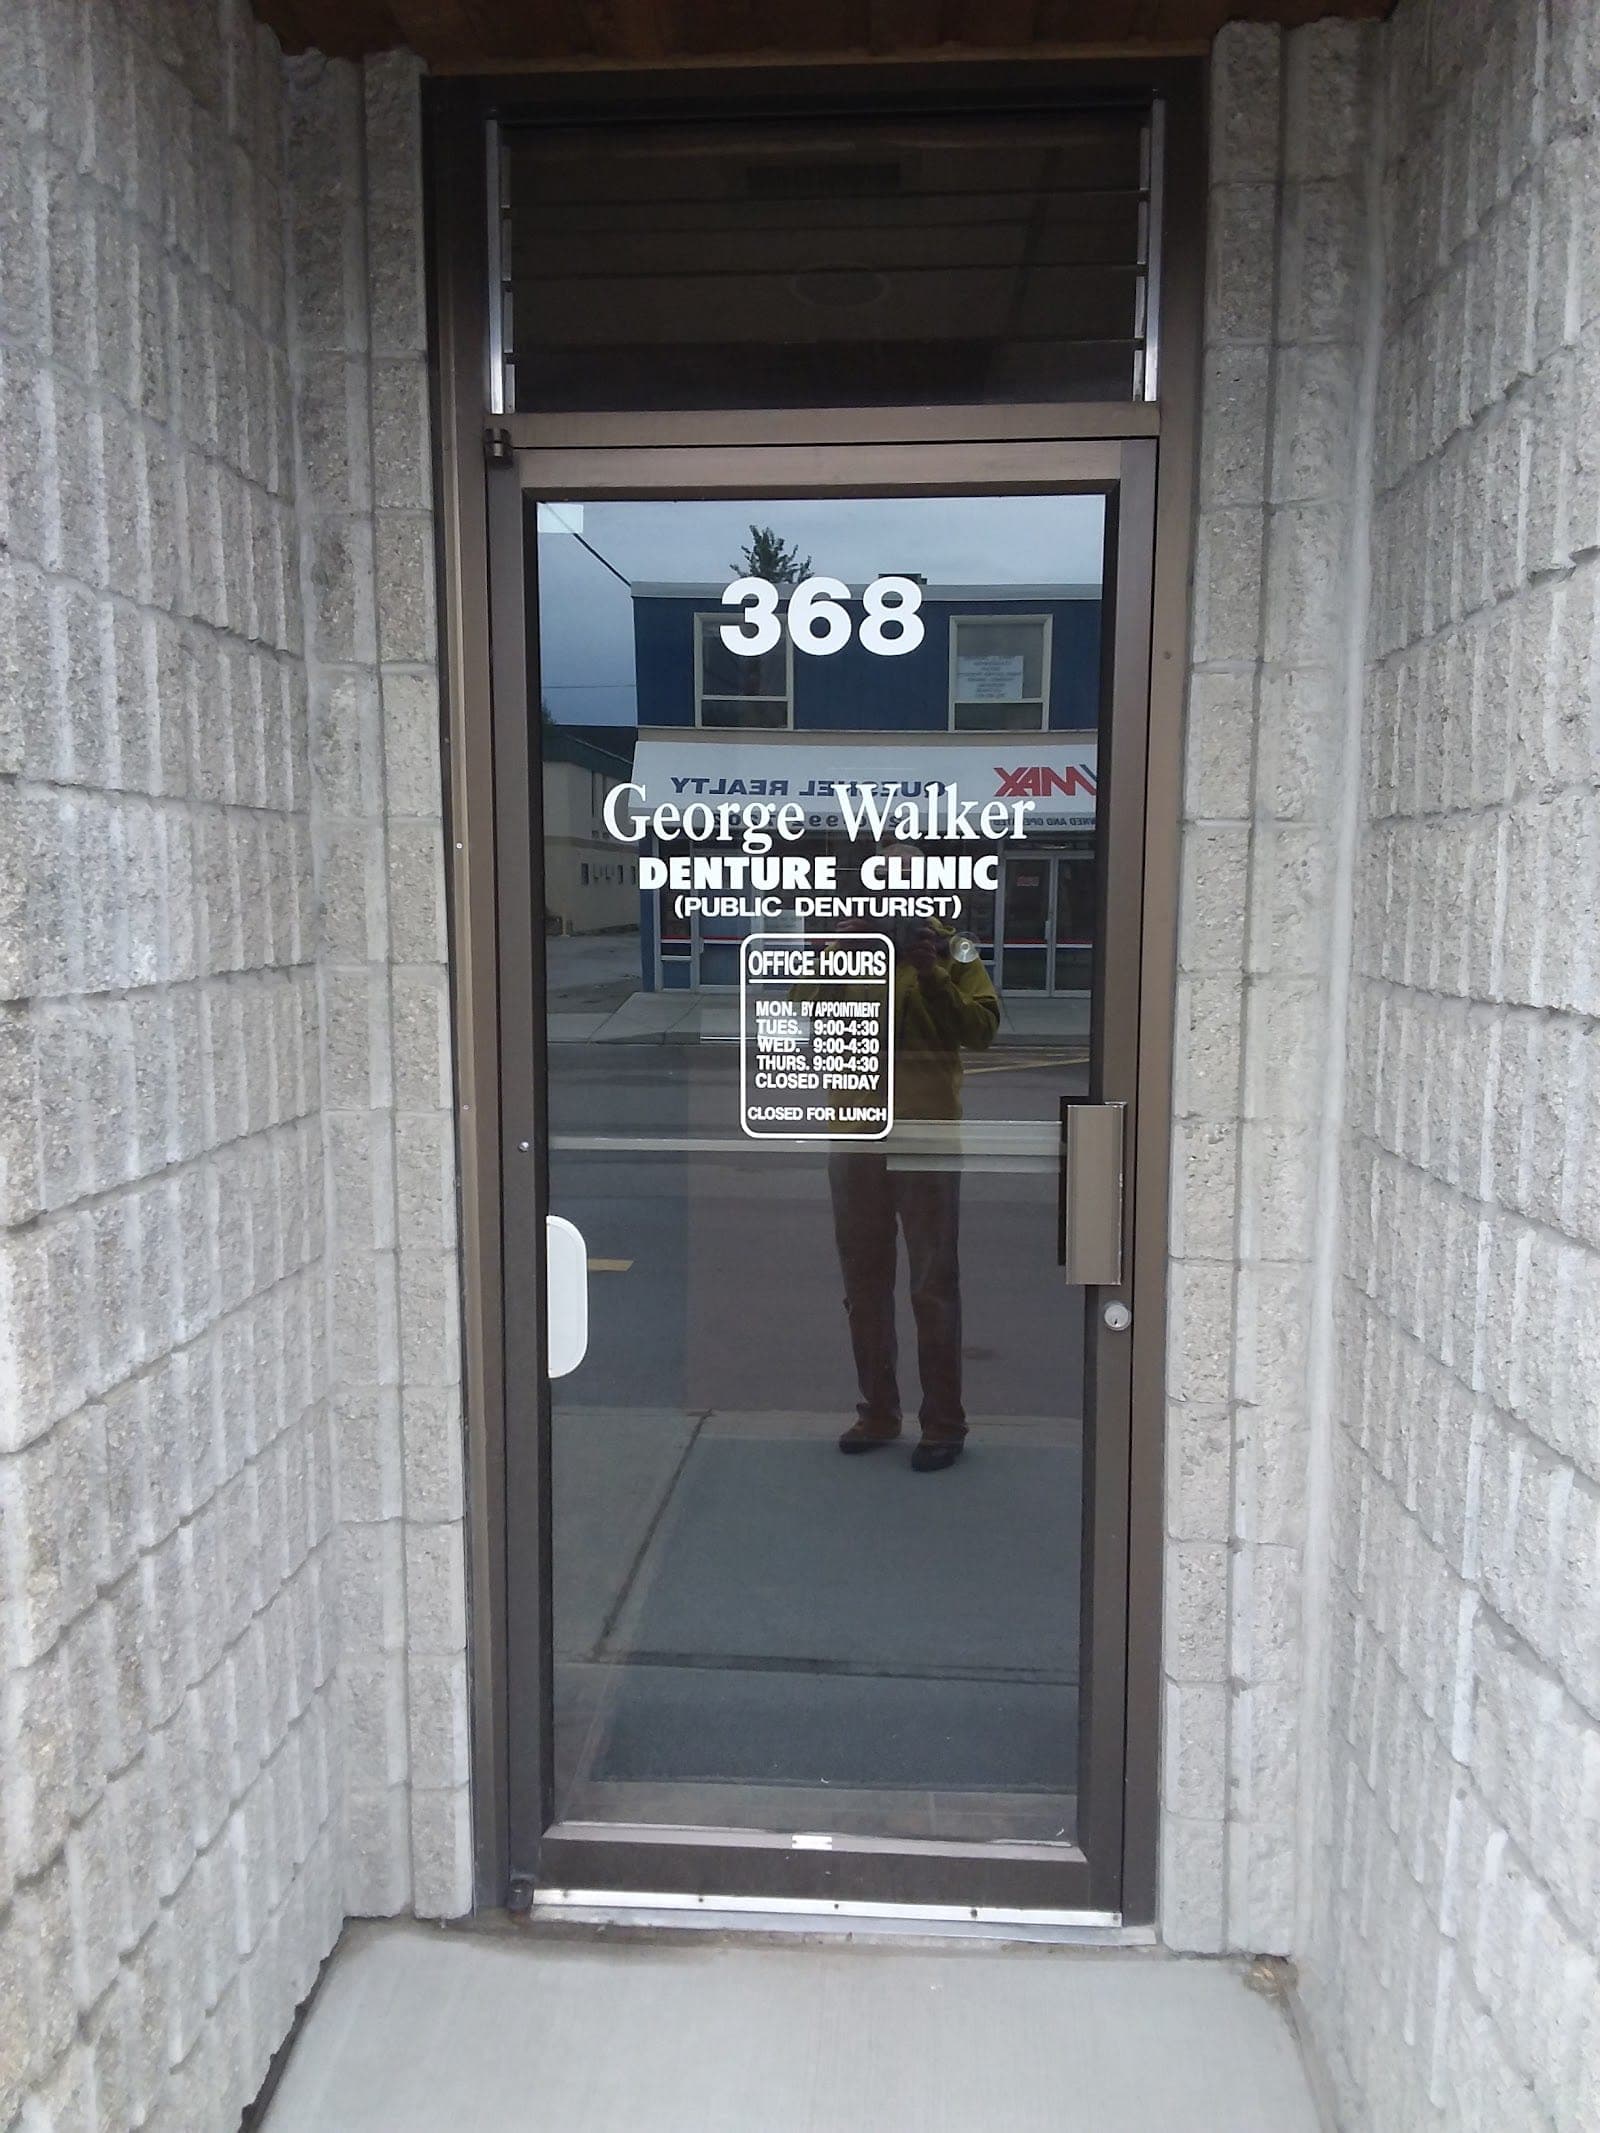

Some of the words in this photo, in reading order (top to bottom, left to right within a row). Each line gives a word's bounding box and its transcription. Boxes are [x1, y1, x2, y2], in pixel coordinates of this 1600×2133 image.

[719, 575, 926, 656] 368
[602, 782, 806, 855] George
[829, 782, 1036, 843] Walker
[638, 856, 838, 891] DENTURE
[860, 855, 999, 891] CLINIC
[674, 895, 782, 920] (PUBLIC
[795, 895, 962, 920] DENTURIST)
[748, 950, 815, 977] OFFICE
[820, 950, 887, 977] HOURS
[755, 1000, 797, 1017] MON.
[801, 1001, 814, 1018] BY
[814, 1001, 881, 1018] APPOINTMENT
[756, 1019, 802, 1036] TUES.
[814, 1019, 879, 1036] 9:00-4:30
[757, 1037, 801, 1054] WED.
[813, 1037, 880, 1054] 9:00-4:30
[756, 1054, 810, 1072] THURS.
[813, 1055, 879, 1072] 9:00-4:30
[755, 1072, 819, 1090] CLOSED
[822, 1074, 881, 1091] FRIDAY
[747, 1106, 804, 1121] CLOSED
[806, 1106, 836, 1121] FOR
[838, 1106, 887, 1122] LUNCH
